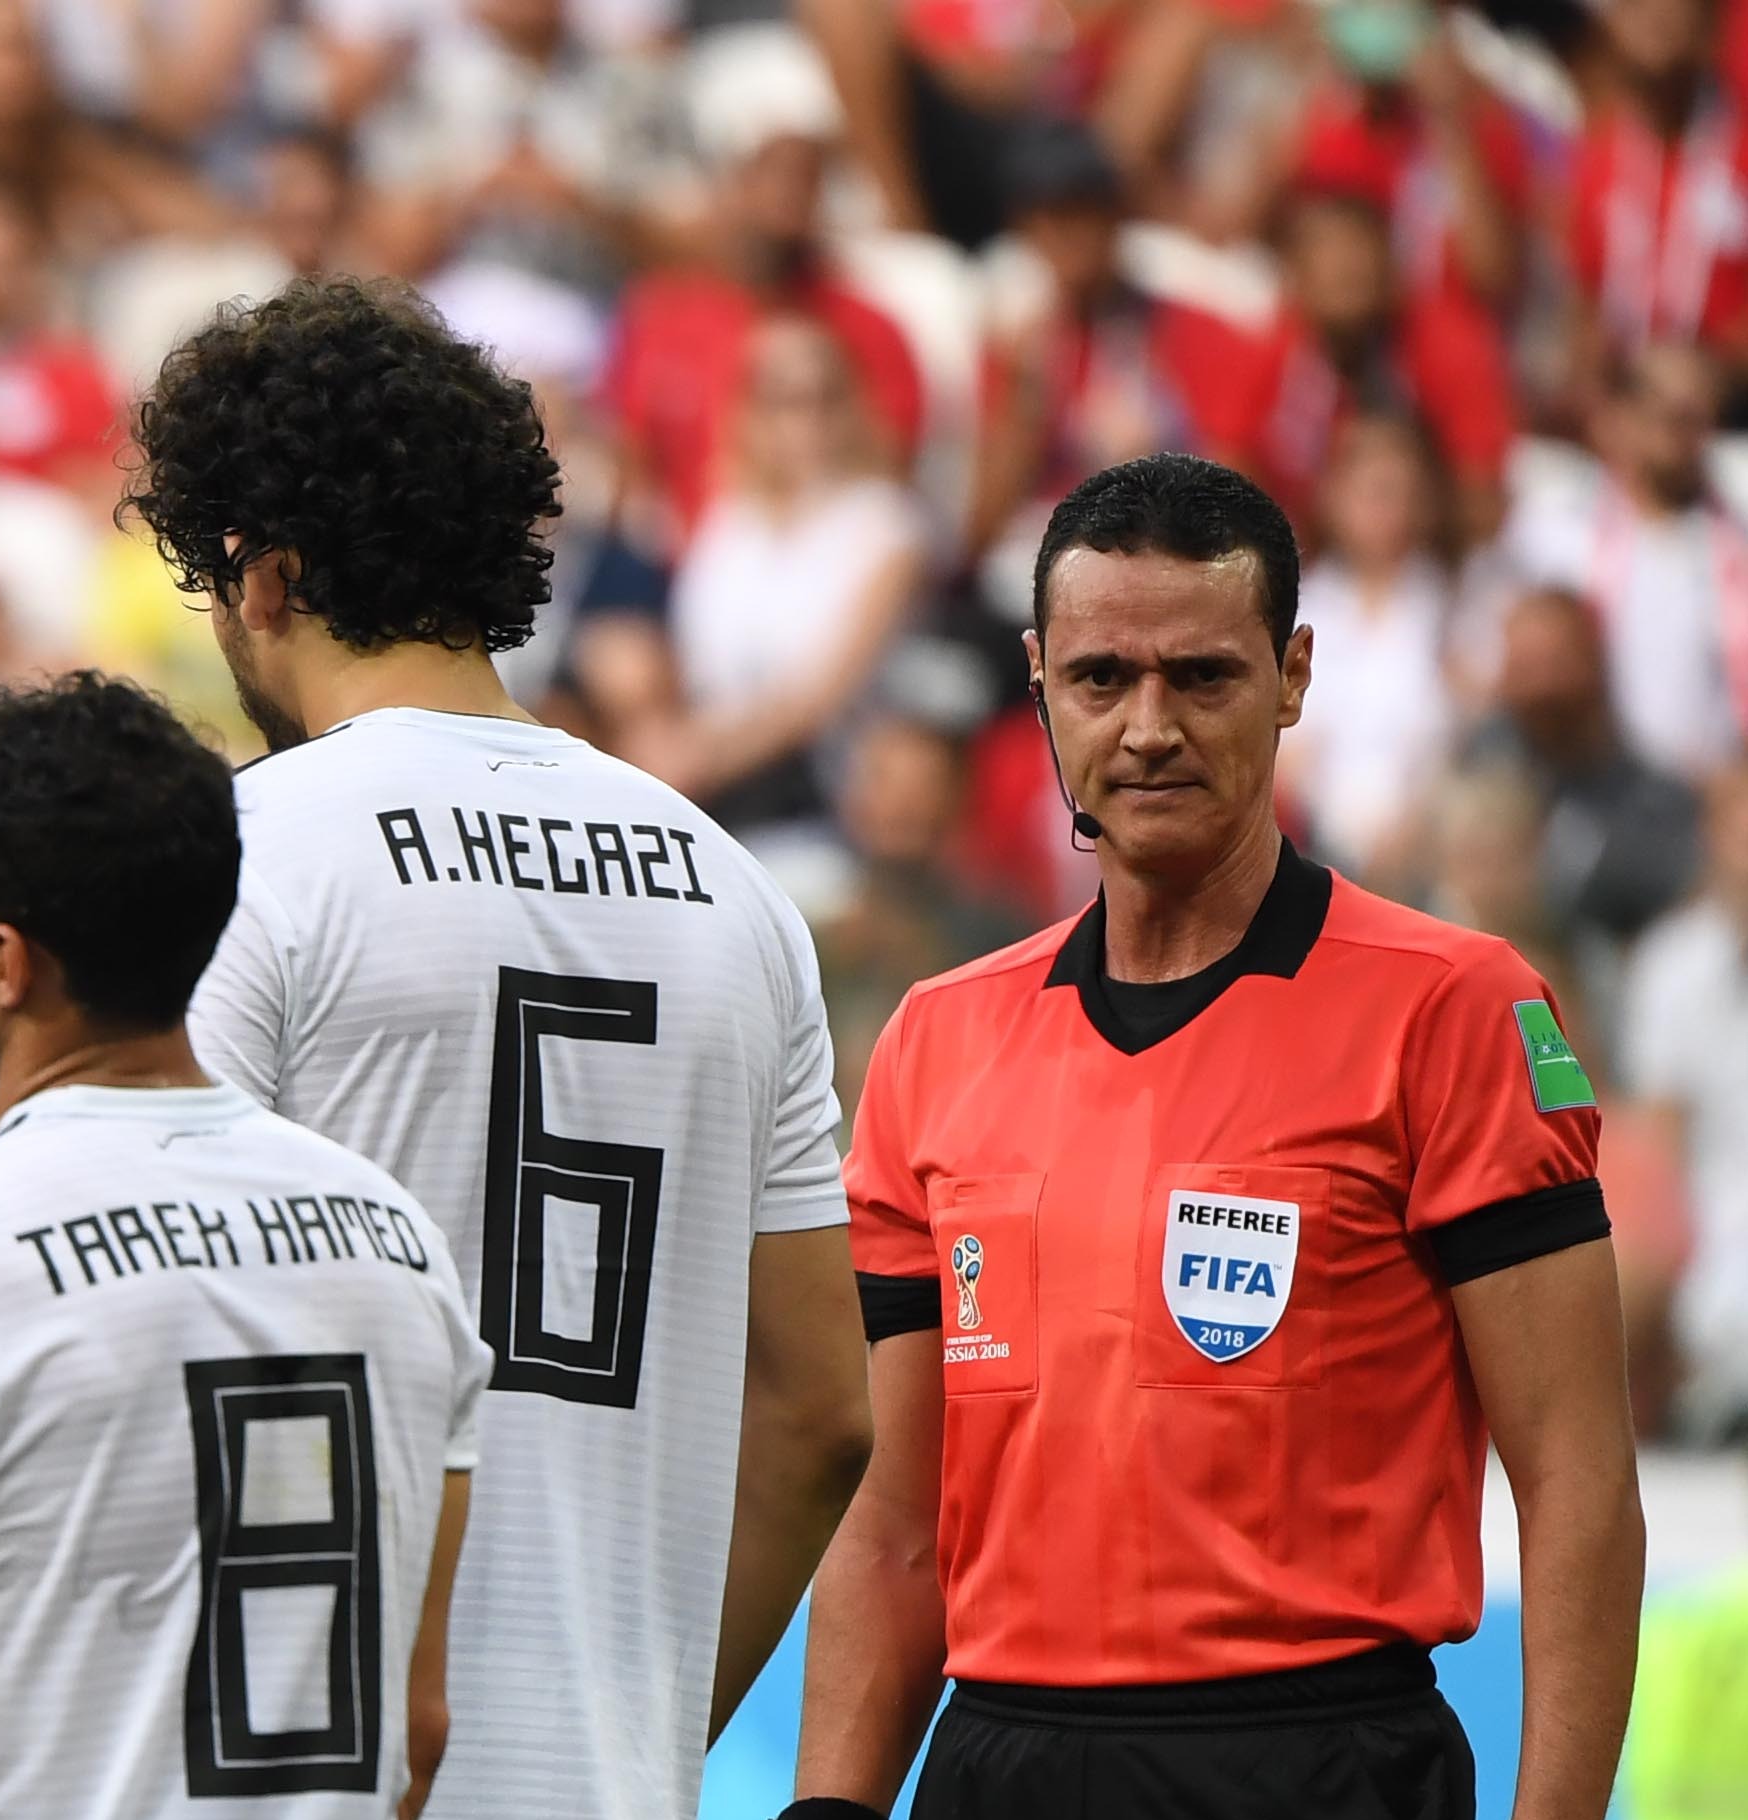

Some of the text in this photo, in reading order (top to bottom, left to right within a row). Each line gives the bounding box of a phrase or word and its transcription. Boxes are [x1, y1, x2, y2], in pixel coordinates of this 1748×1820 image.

[375, 807, 715, 906] A.HEGAZI
[479, 965, 665, 1410] 6
[1177, 1202, 1292, 1236] REFEREE
[15, 1196, 429, 1296] TAREK HAMED
[1178, 1253, 1276, 1298] FIFA
[979, 1342, 1011, 1360] 2018
[1198, 1326, 1246, 1348] 2018
[183, 1353, 382, 1798] 8
